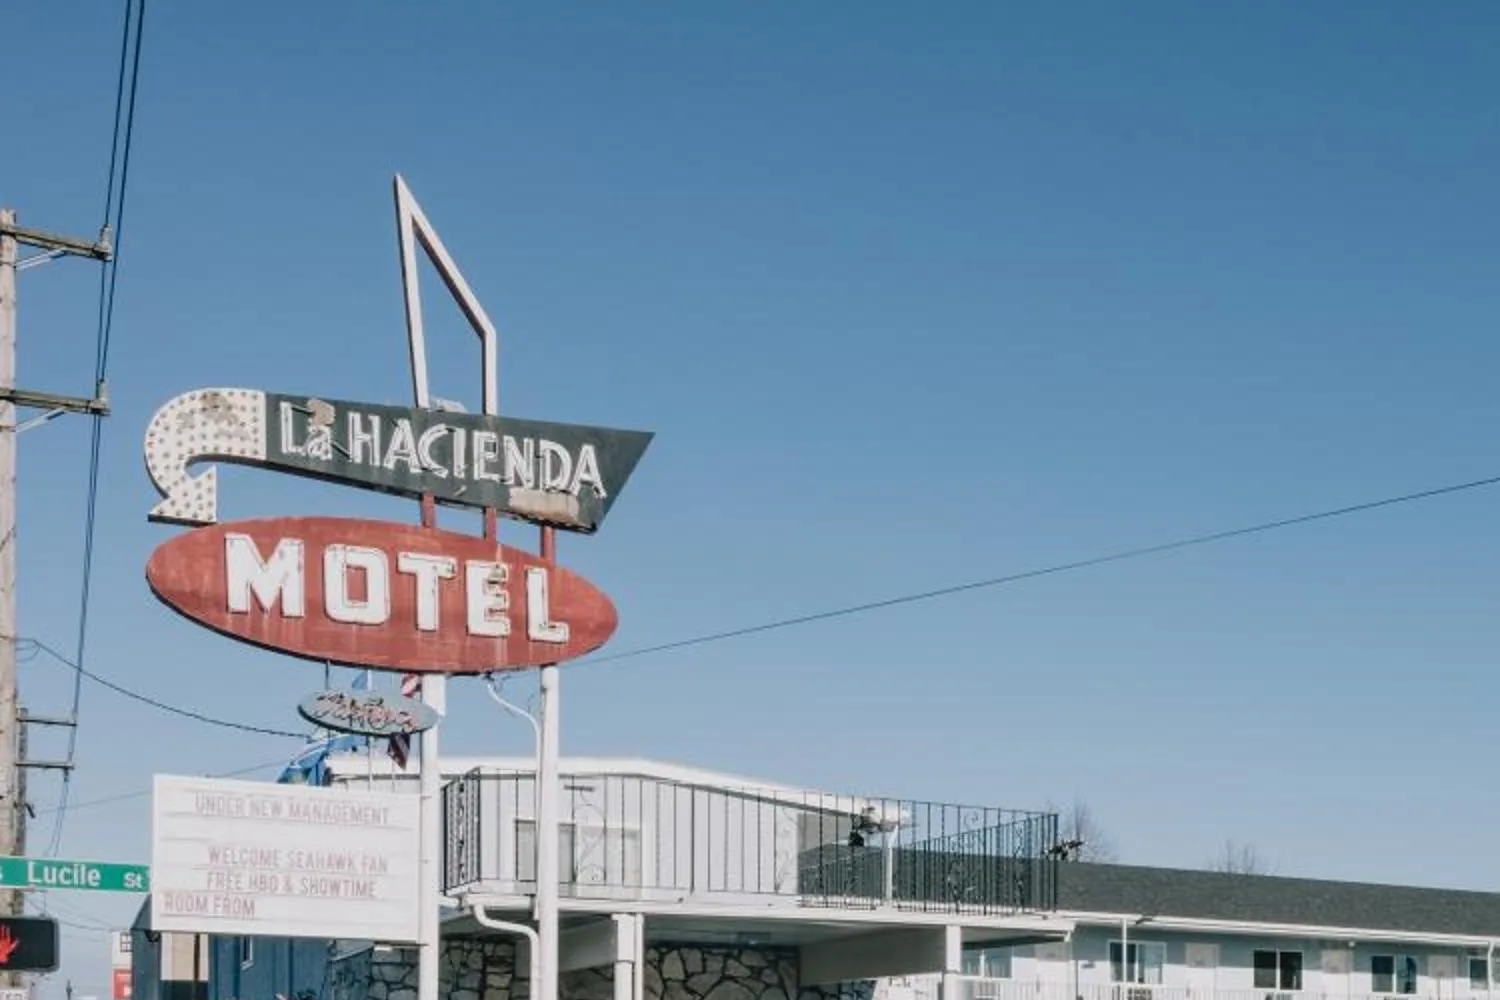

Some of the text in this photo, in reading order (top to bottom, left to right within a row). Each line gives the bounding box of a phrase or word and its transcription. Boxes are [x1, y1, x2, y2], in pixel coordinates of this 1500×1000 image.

[280, 401, 607, 499] La HACIENDA
[225, 532, 570, 643] MOTEL
[195, 793, 389, 825] UNDER NEW MANAGEMENT
[209, 847, 388, 873] WELCOME SEAHAWK FAN
[27, 861, 101, 887] Lucile
[207, 871, 242, 891] FREE
[249, 874, 278, 892] HBO
[302, 877, 376, 898] SHOWTIME
[164, 892, 256, 917] ROOM FROM
